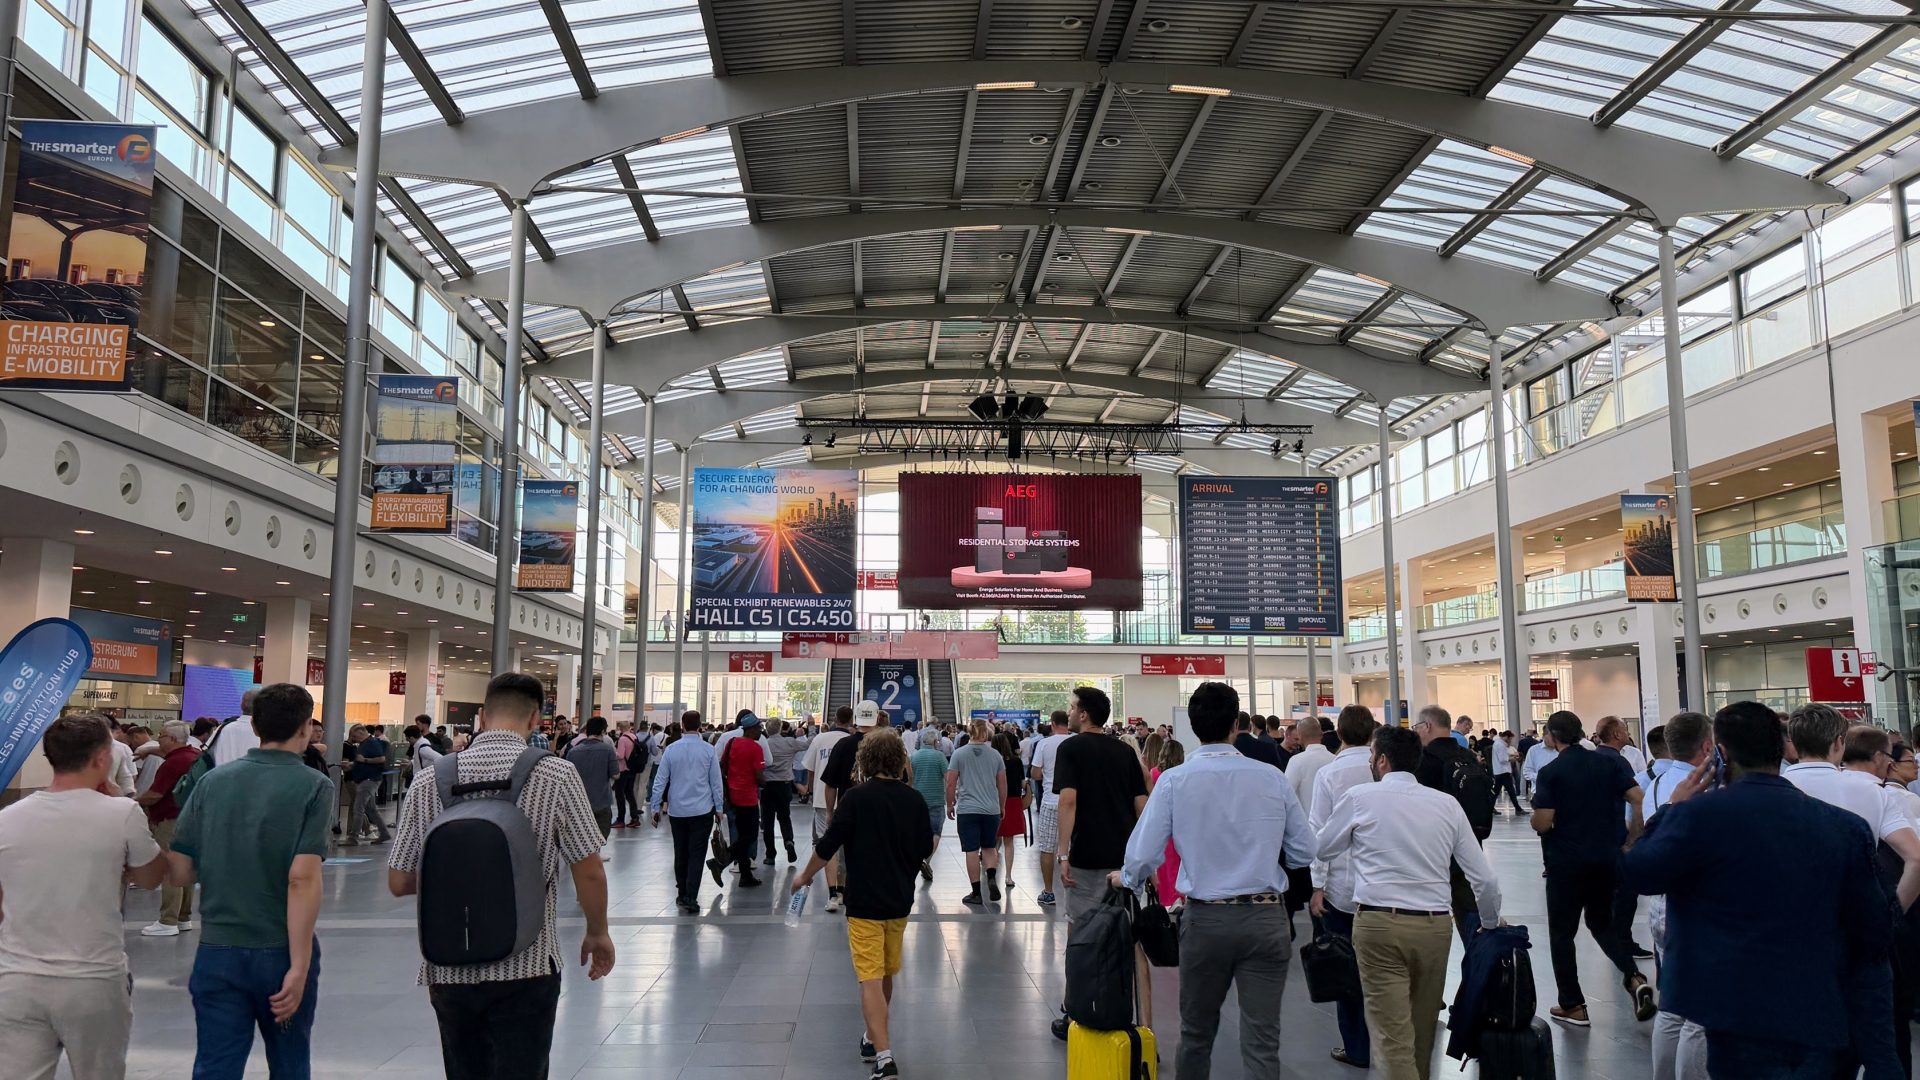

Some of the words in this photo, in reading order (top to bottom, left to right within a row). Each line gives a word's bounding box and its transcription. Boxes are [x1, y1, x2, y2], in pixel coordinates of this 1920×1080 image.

[8, 324, 123, 346] CHARGING
[7, 343, 121, 359] INFRASTRUCTURE
[4, 356, 120, 376] E-MOBILITY
[699, 474, 735, 483] SECURE
[738, 475, 775, 484] ENERGY
[699, 484, 718, 492] FOR
[720, 484, 727, 493] A
[729, 484, 778, 494] CHANGING
[780, 486, 815, 494] WORLD
[1005, 485, 1037, 498] AEG
[1192, 483, 1234, 493] ARRIVAL
[377, 502, 412, 512] SMART
[414, 503, 445, 513] GRIDS
[376, 512, 444, 524] FLEXIBILITY
[958, 538, 1007, 546] RESIDENTIAL
[1045, 539, 1080, 547] SYSTEMS
[521, 580, 567, 588] INDUSTRY
[1631, 590, 1671, 598] INDUSTRY
[695, 598, 731, 606] SPECIAL
[734, 598, 768, 607] EXHIBIT
[771, 598, 831, 607] RENEWABLES
[833, 599, 852, 608] 24/7
[695, 608, 744, 625] HALL
[749, 608, 772, 625] C5
[787, 610, 853, 626] C5.450
[742, 660, 765, 672] B,C
[1185, 662, 1196, 674] A
[881, 671, 900, 680] TOP
[3, 664, 34, 704] ees
[10, 673, 61, 742] INNOVATION
[57, 648, 79, 674] HUB
[83, 691, 118, 700] SUPERMARKET
[881, 680, 902, 710] 2
[27, 708, 53, 734] HALL
